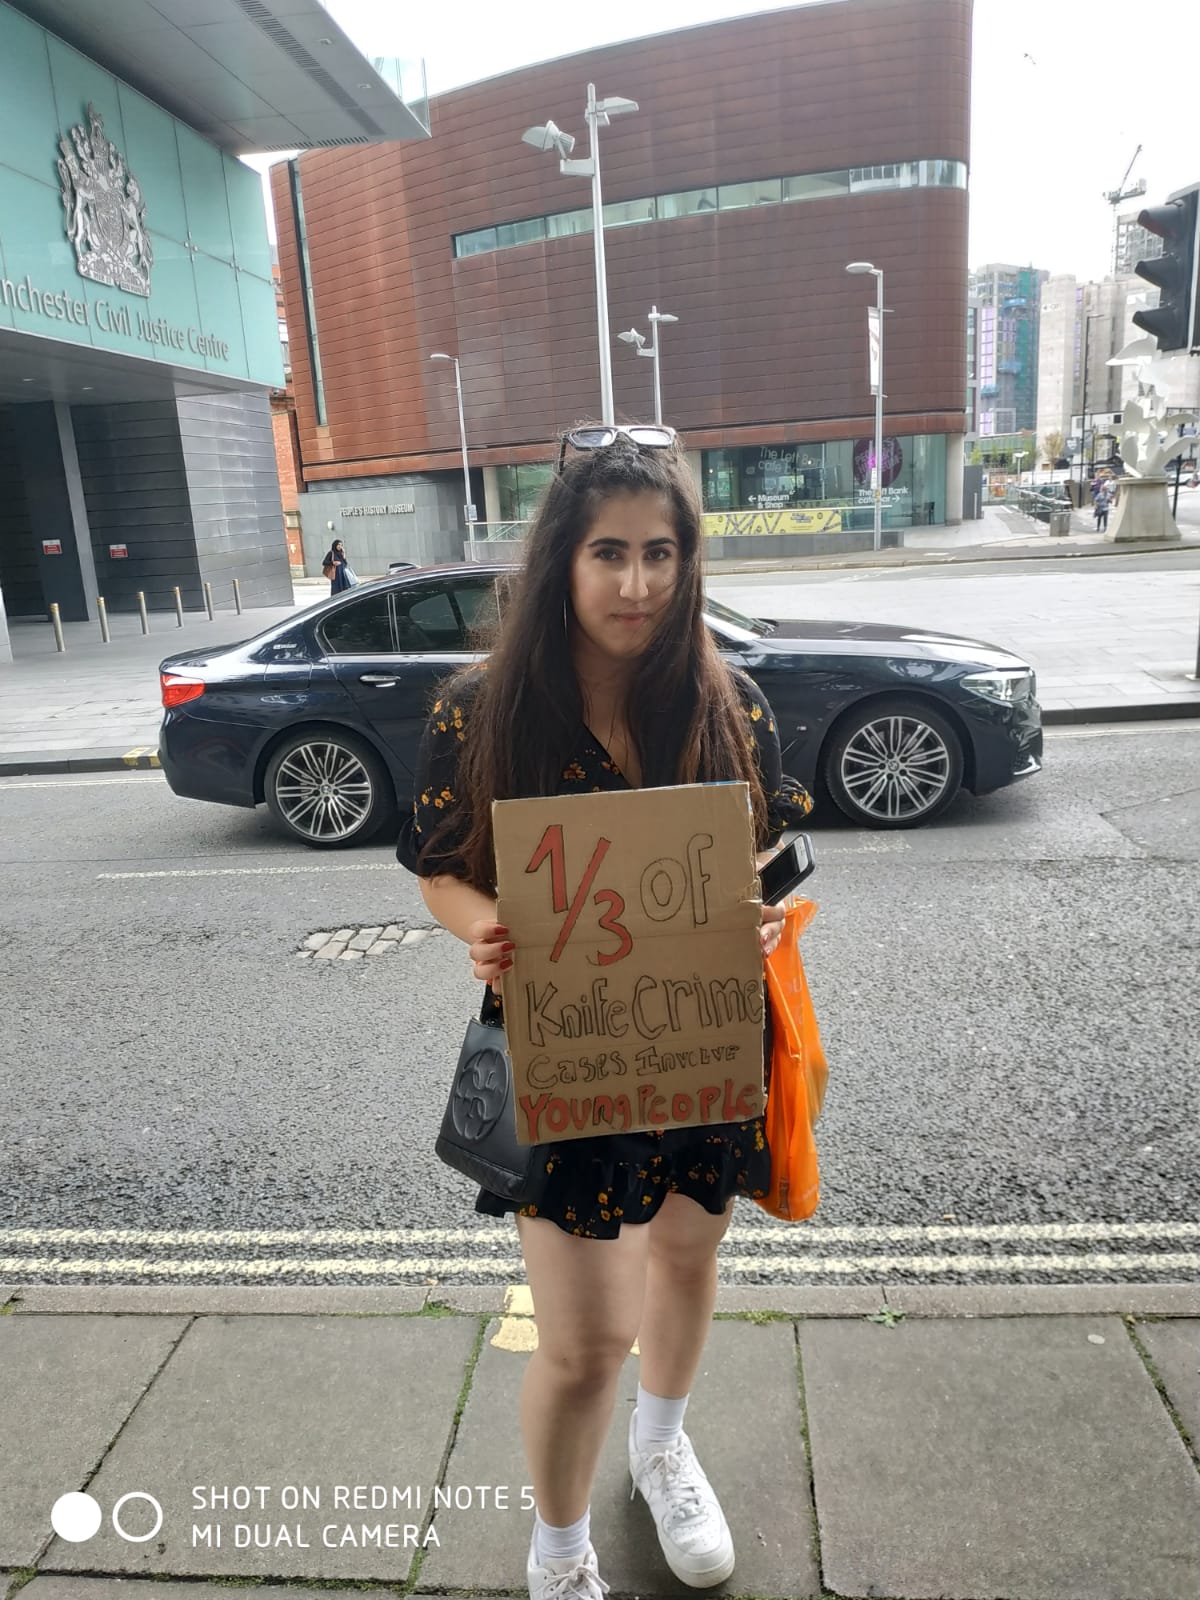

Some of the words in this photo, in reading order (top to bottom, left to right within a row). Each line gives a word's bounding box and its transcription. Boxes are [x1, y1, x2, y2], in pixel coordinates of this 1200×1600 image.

[0, 274, 91, 326] nchester
[95, 300, 132, 337] Civil
[137, 311, 184, 351] Justice
[187, 327, 229, 361] Centre
[760, 446, 778, 460] The
[757, 493, 790, 502] Museum
[888, 486, 909, 495] Bank
[765, 501, 784, 510] Shop
[525, 824, 634, 967] 1/3
[525, 977, 630, 1048] Knife
[631, 972, 765, 1041] Crime
[526, 1050, 628, 1090] Cases
